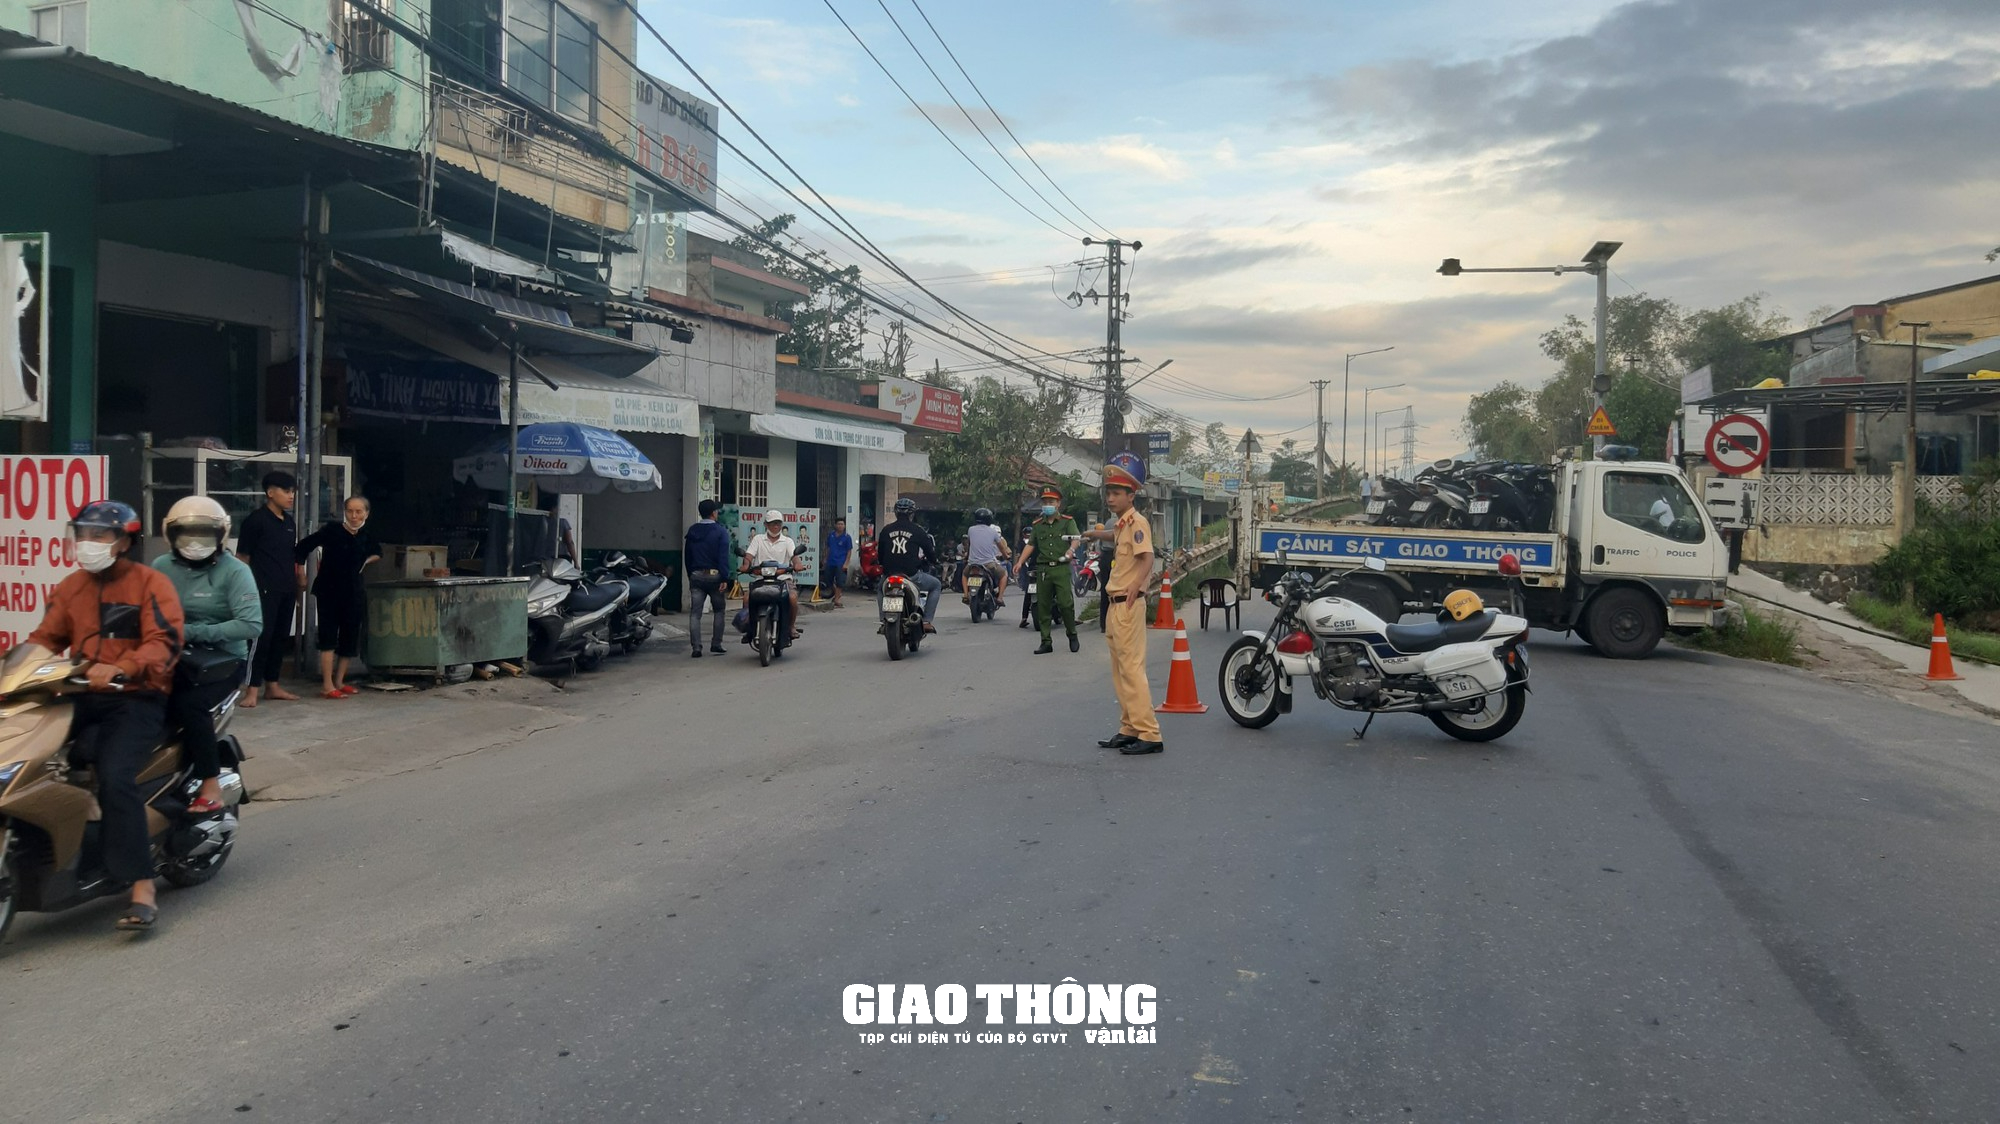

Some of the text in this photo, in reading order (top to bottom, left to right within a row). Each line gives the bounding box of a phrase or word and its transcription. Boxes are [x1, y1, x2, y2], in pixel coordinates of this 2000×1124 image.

[926, 399, 941, 413] MINH
[523, 455, 567, 470] Vikoda
[800, 510, 816, 522] GẤP
[1277, 534, 1537, 562] CẢNH SÁT GIAO THÔNG
[1607, 548, 1697, 558] TRAFFIC POLICE
[1333, 619, 1356, 628] CSGT
